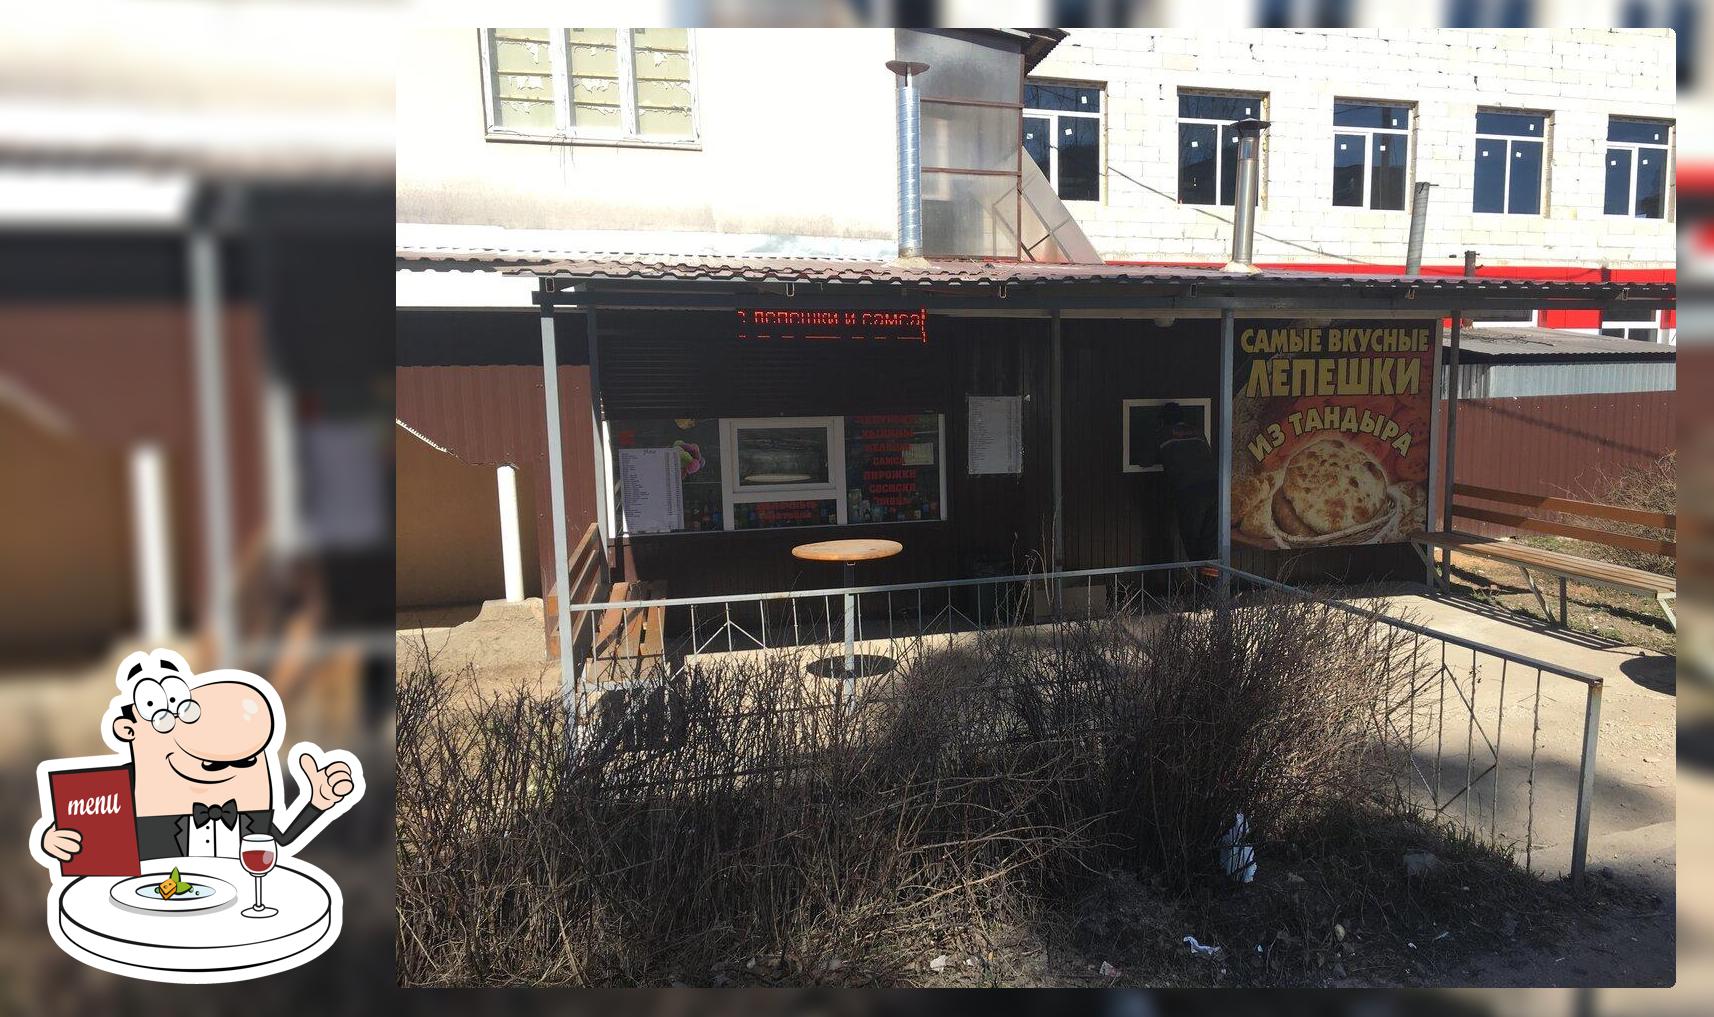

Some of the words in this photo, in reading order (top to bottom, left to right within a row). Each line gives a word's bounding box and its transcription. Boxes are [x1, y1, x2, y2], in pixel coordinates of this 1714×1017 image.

[1240, 328, 1322, 353] САМЫЕ
[1327, 328, 1430, 353] ВКУСНЫЕ
[1246, 357, 1421, 398] ЛЕПЕШКИ
[1247, 423, 1286, 463] ИЗ
[1288, 406, 1413, 457] ТАНДЫРА
